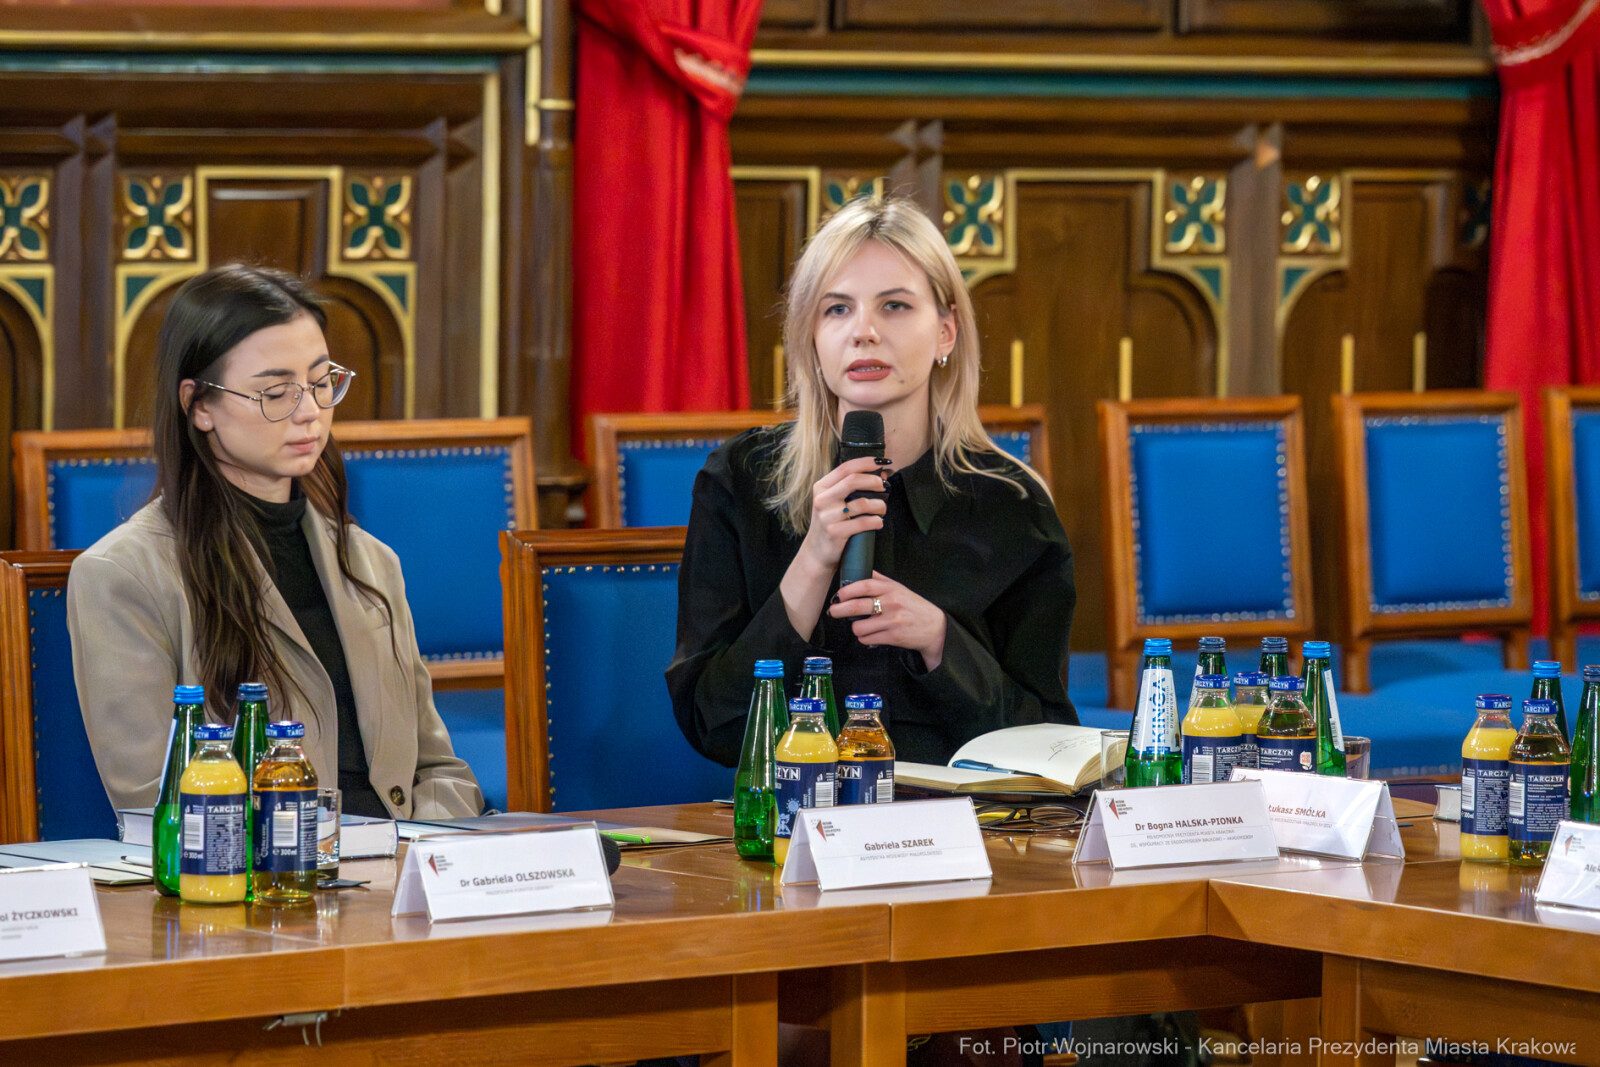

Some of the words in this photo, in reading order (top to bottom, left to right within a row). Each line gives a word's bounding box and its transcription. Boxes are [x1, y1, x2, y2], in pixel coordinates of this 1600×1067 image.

[1260, 748, 1294, 756] TARCZYN
[1528, 775, 1564, 783] TARCZYN
[1295, 806, 1326, 819] SMÓŁKA
[1135, 823, 1145, 831] Dr
[1147, 821, 1173, 832] Bogna
[1175, 816, 1244, 828] HALSKA-PIONKA
[864, 841, 900, 851] Gabriela
[901, 838, 935, 848] SZAREK
[460, 879, 470, 887] Dr
[473, 874, 514, 886] Gabriela
[516, 868, 575, 882] OLSZOWSKA
[12, 907, 78, 921] ŻYCZKOWSKI
